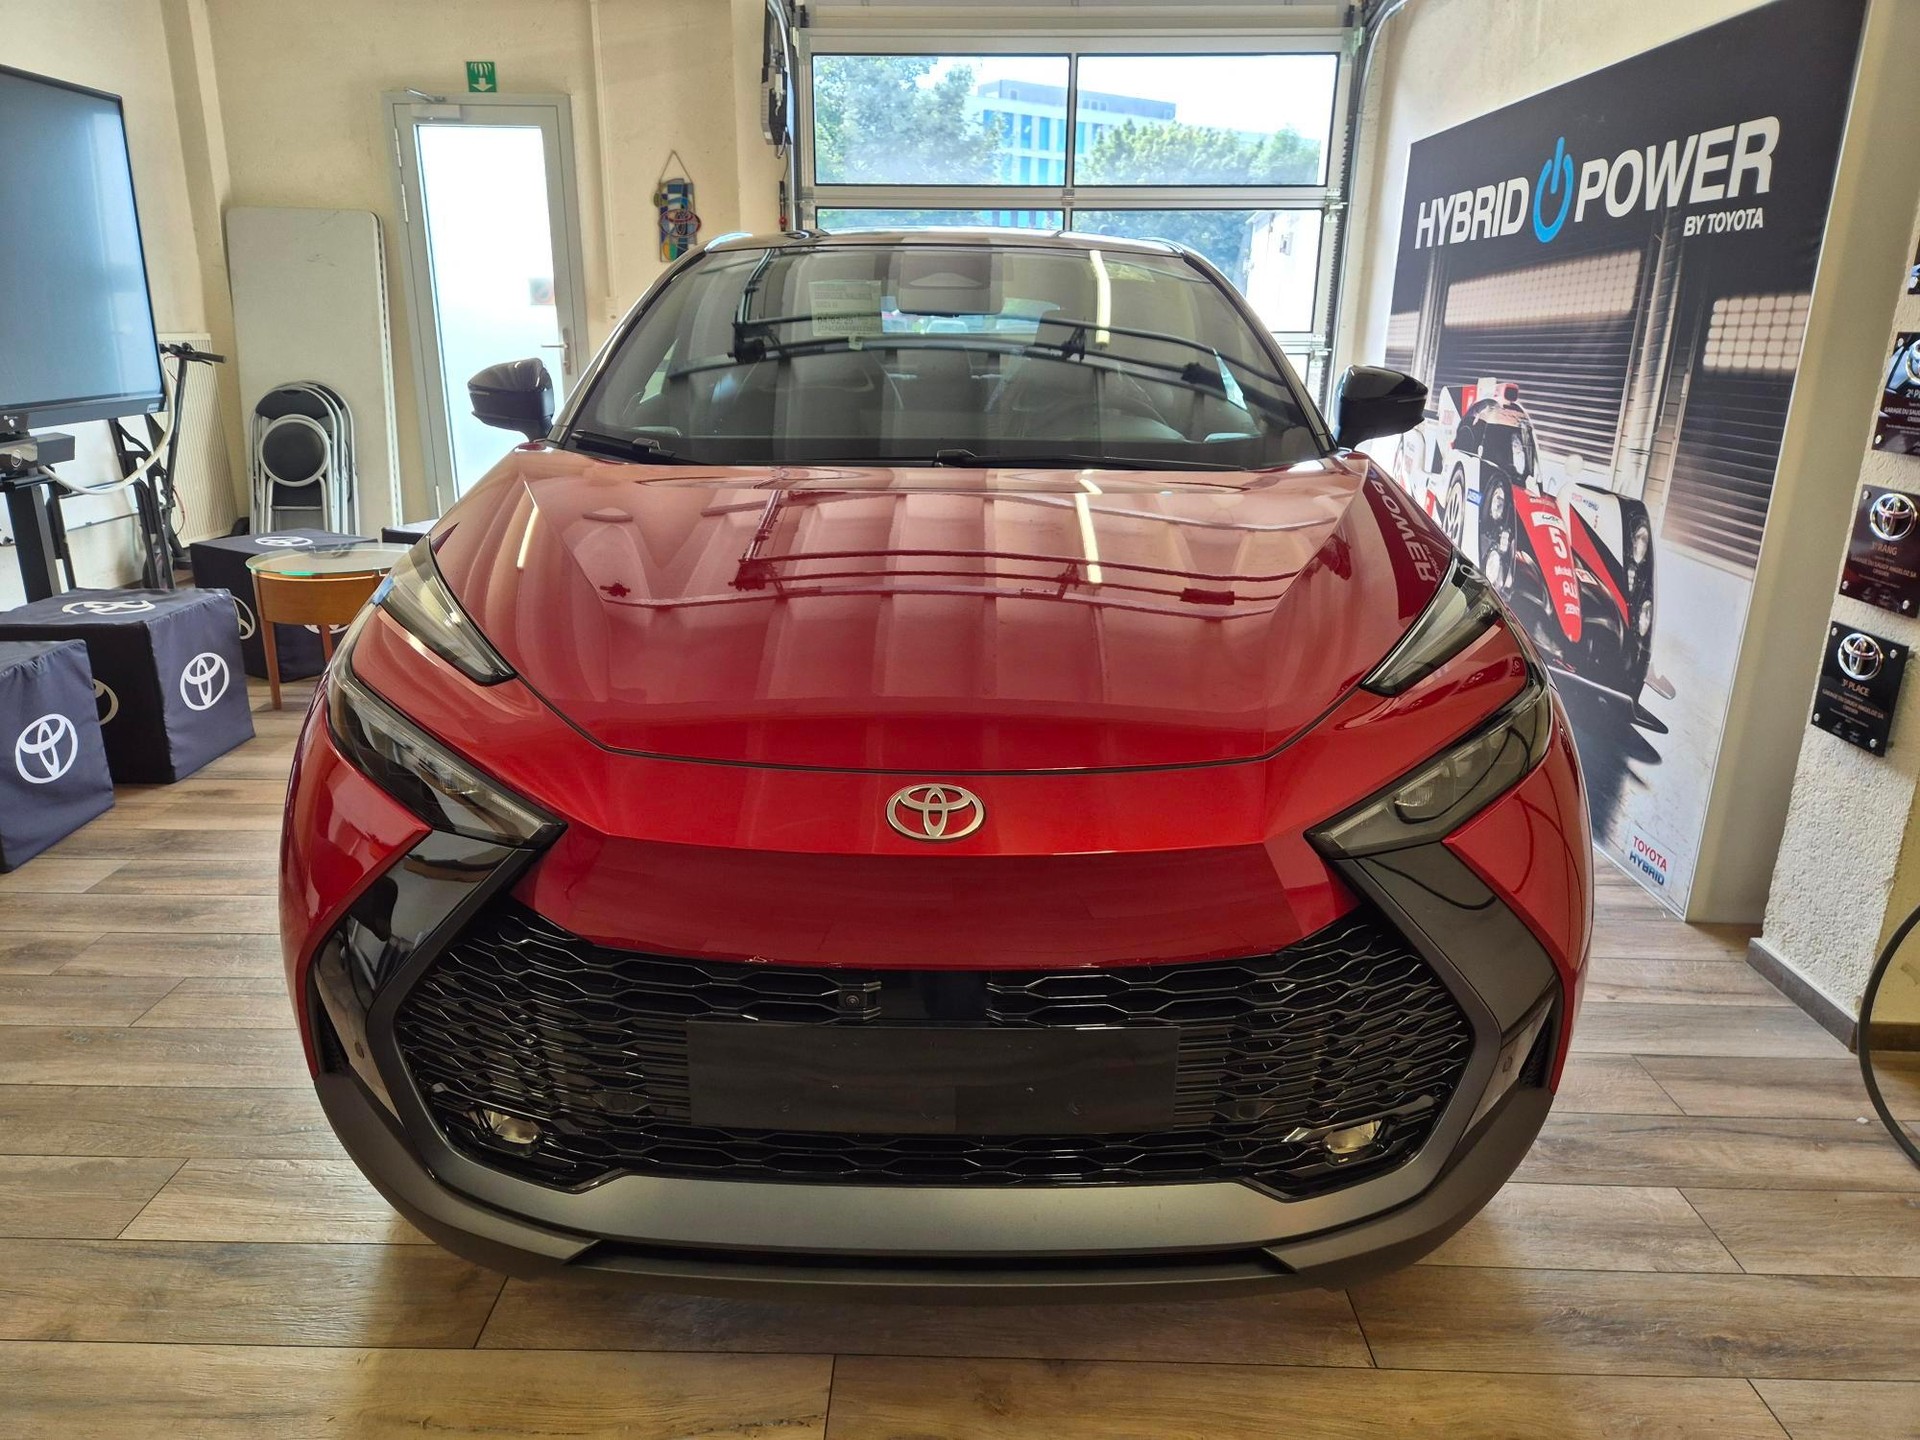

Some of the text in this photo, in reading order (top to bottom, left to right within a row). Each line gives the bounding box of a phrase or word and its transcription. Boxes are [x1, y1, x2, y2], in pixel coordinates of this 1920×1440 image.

[1414, 116, 1780, 249] HYBRID POWER
[1683, 207, 1764, 237] BY TOYOTA
[1548, 526, 1568, 559] 5
[1877, 543, 1898, 556] RANG
[1848, 680, 1871, 697] PLACE
[1629, 850, 1665, 886] HYBRID
[1632, 835, 1667, 873] TOYOTA
